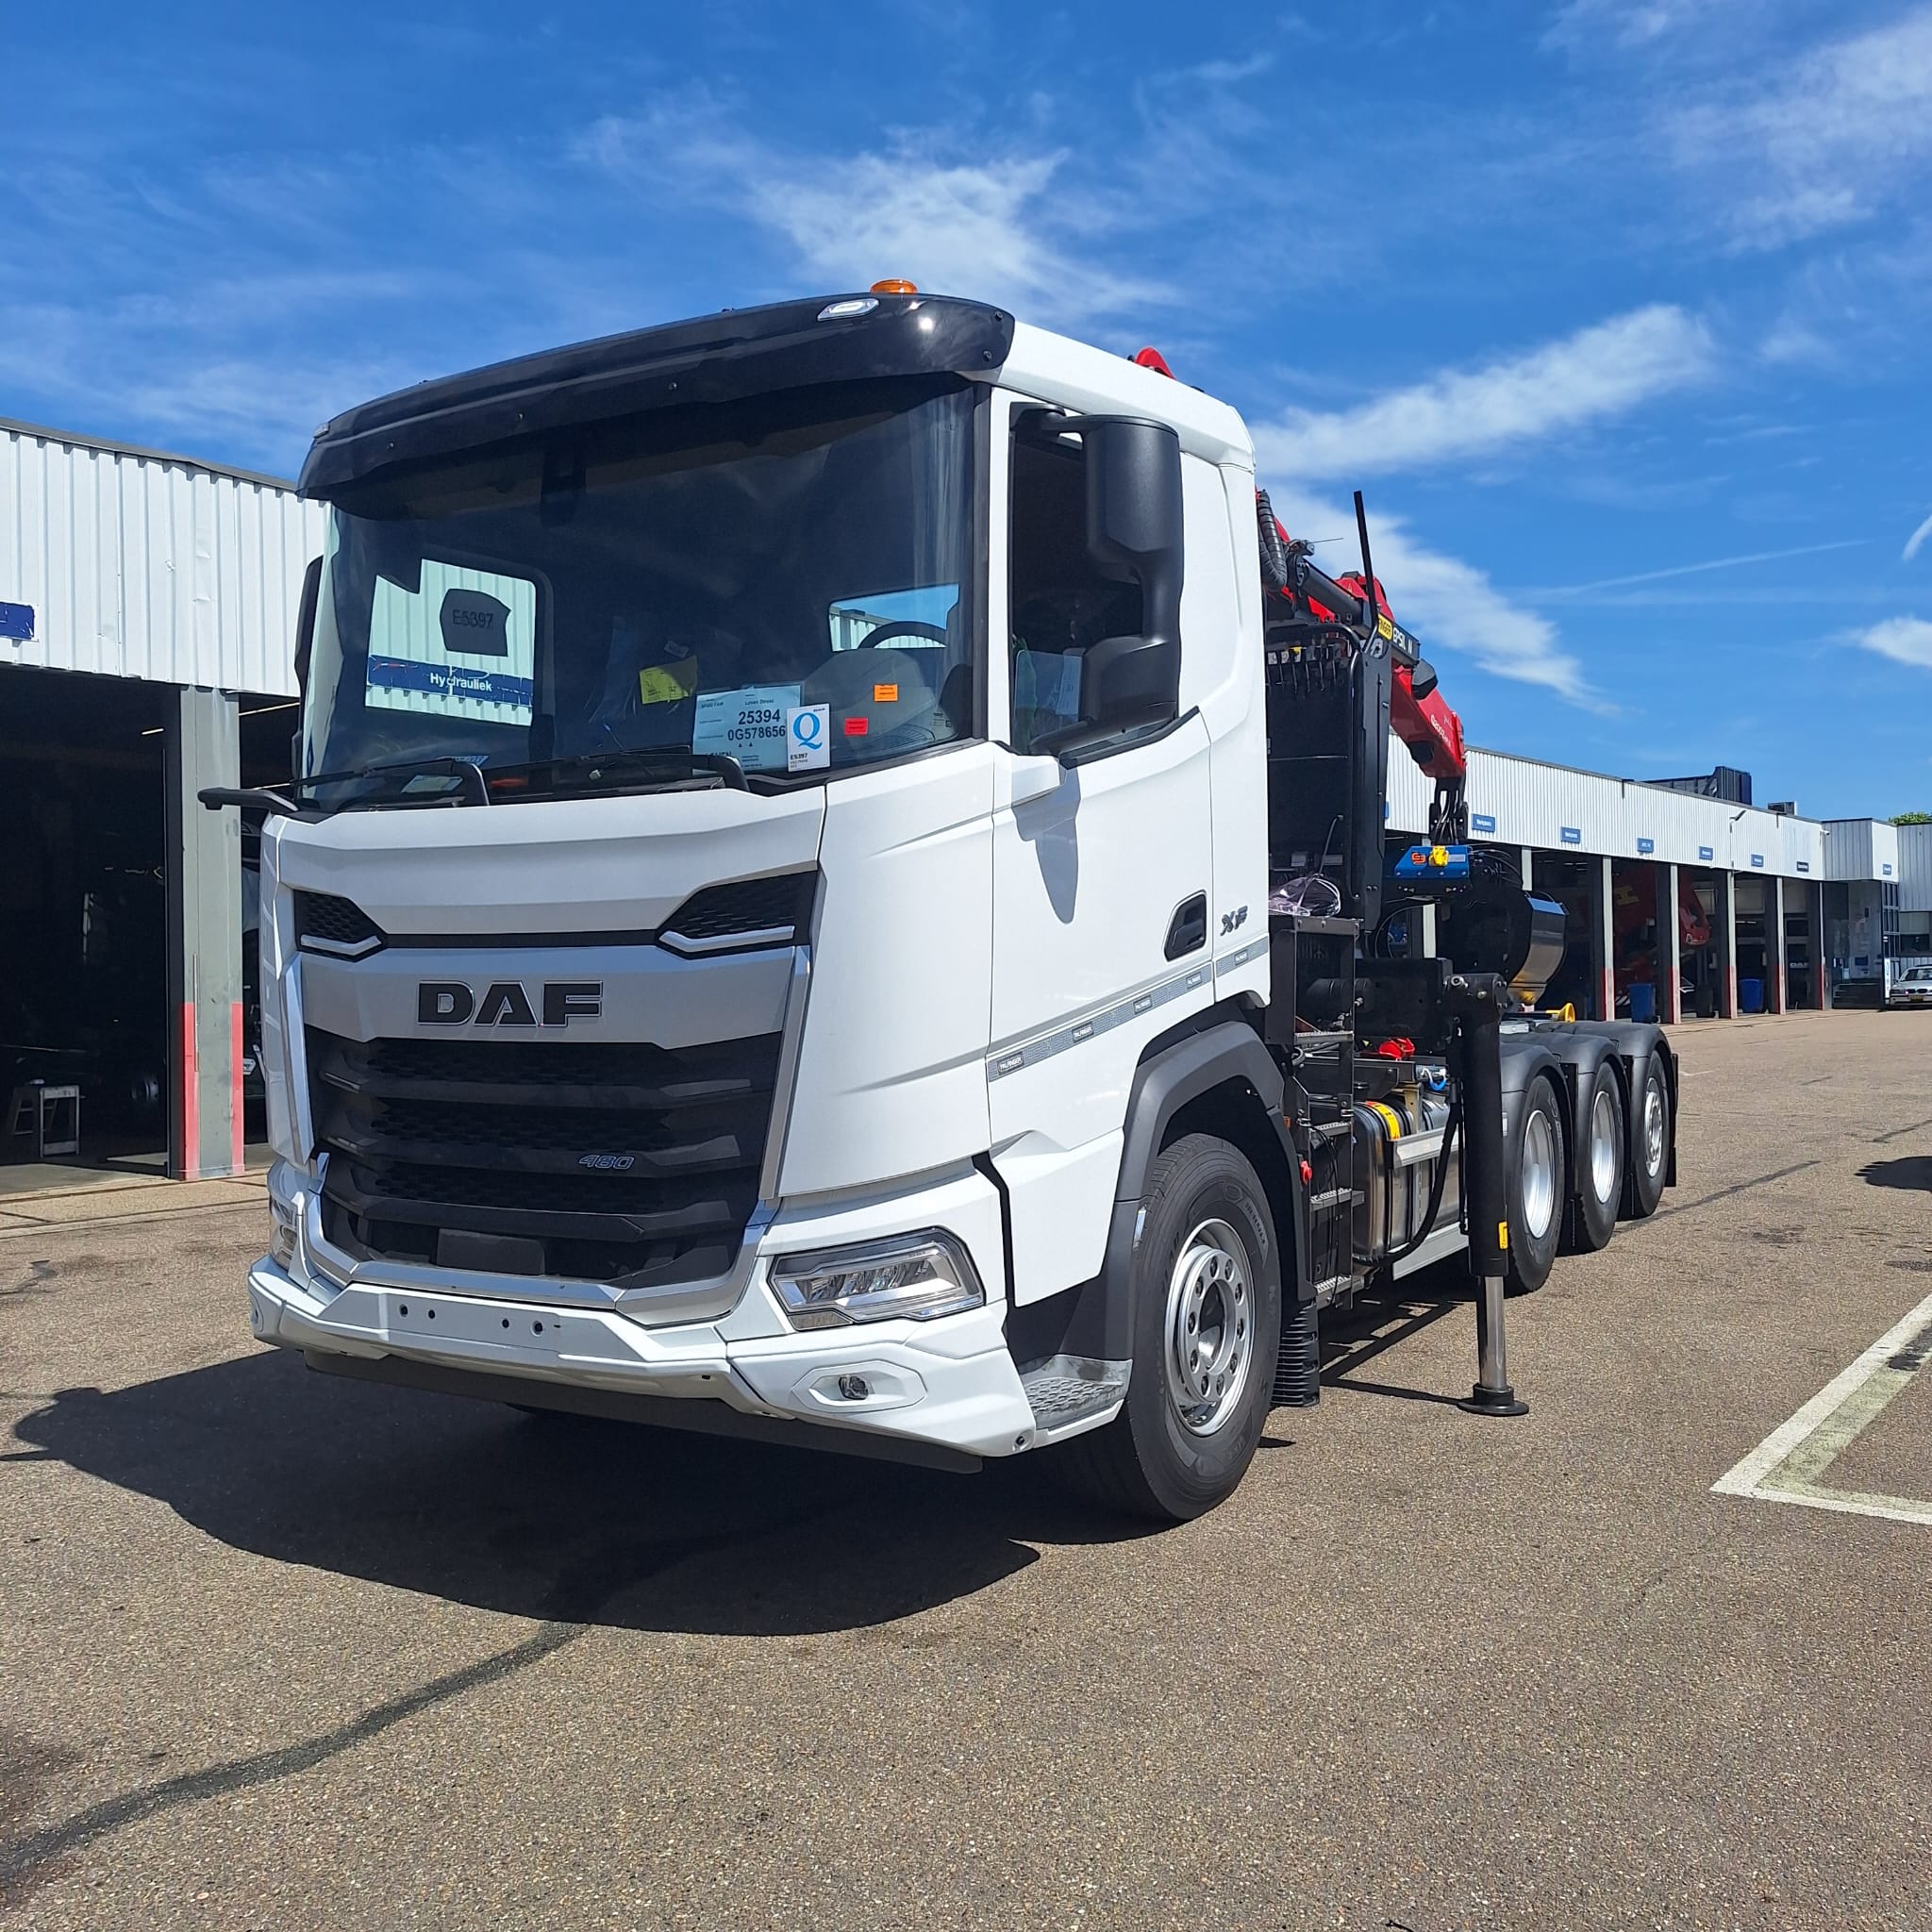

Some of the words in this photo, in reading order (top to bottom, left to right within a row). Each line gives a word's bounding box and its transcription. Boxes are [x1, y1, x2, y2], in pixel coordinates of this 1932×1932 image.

[429, 673, 493, 692] Hydrauliek
[738, 708, 781, 725] 25394
[727, 725, 786, 741] 0G578656
[792, 712, 823, 750] Q
[1220, 905, 1248, 937] XF
[417, 979, 604, 1027] DAF
[578, 1154, 635, 1170] 480
